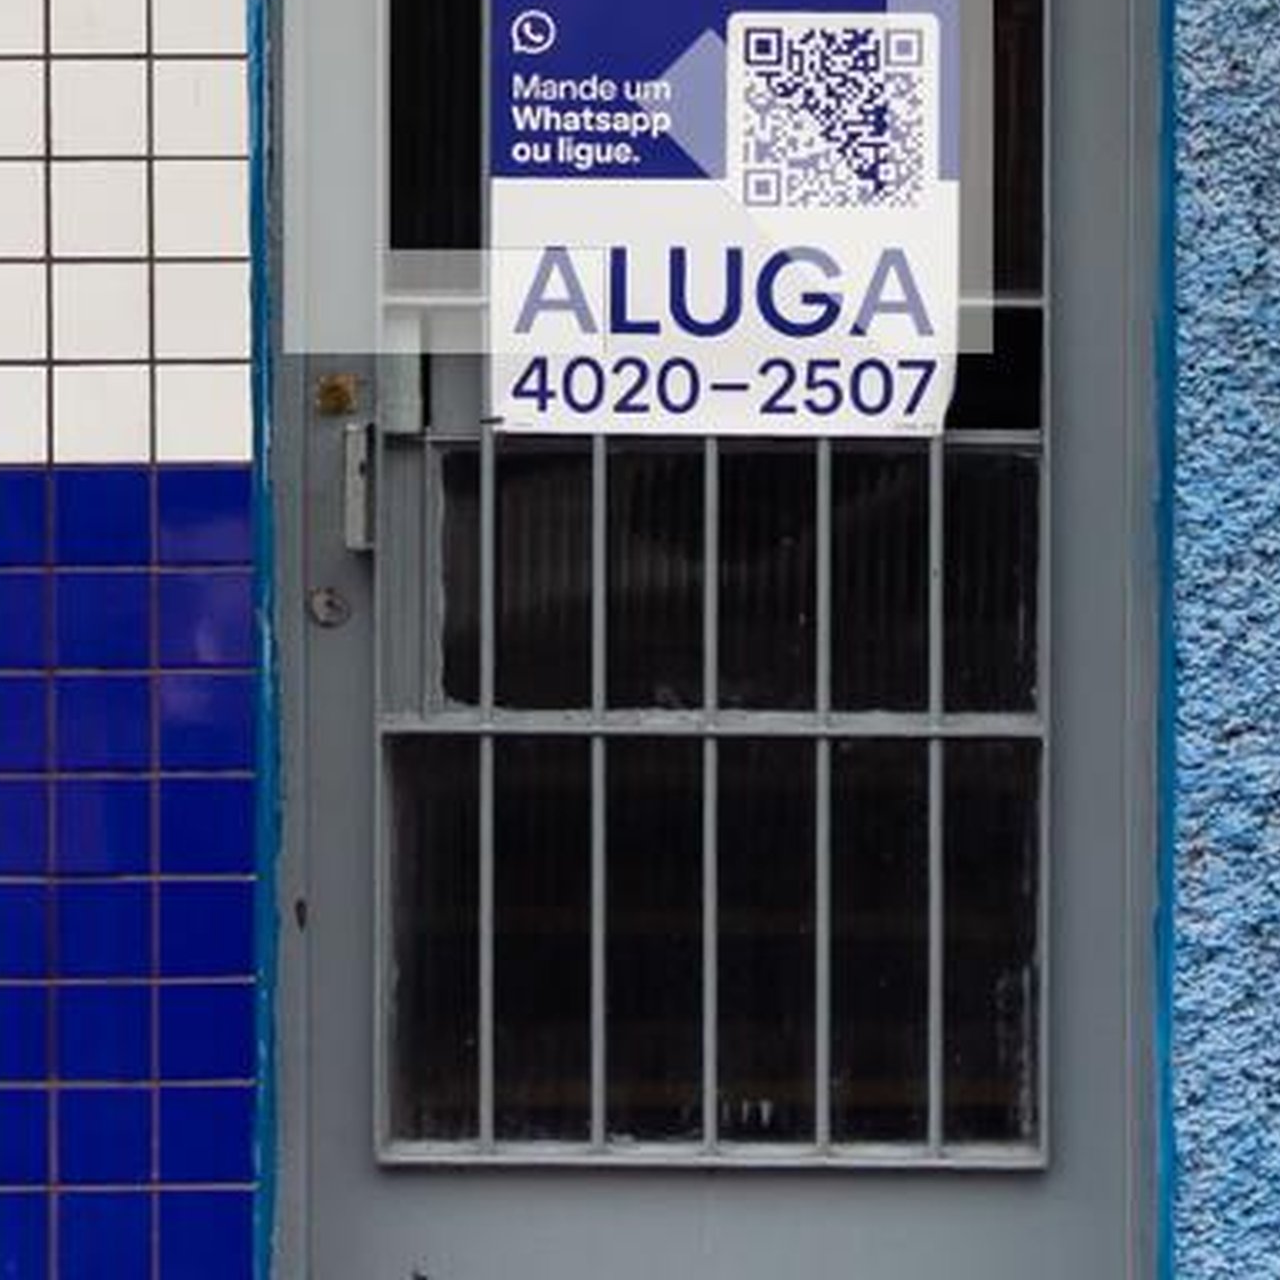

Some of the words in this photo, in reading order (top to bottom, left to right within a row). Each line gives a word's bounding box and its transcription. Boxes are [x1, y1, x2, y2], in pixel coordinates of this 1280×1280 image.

[512, 74, 618, 101] Mande
[623, 80, 671, 101] um
[512, 106, 672, 138] Whatsapp
[512, 142, 551, 162] ou
[557, 136, 641, 170] ligue.
[514, 246, 934, 337] ALUGA
[512, 356, 937, 416] 4020-2507
